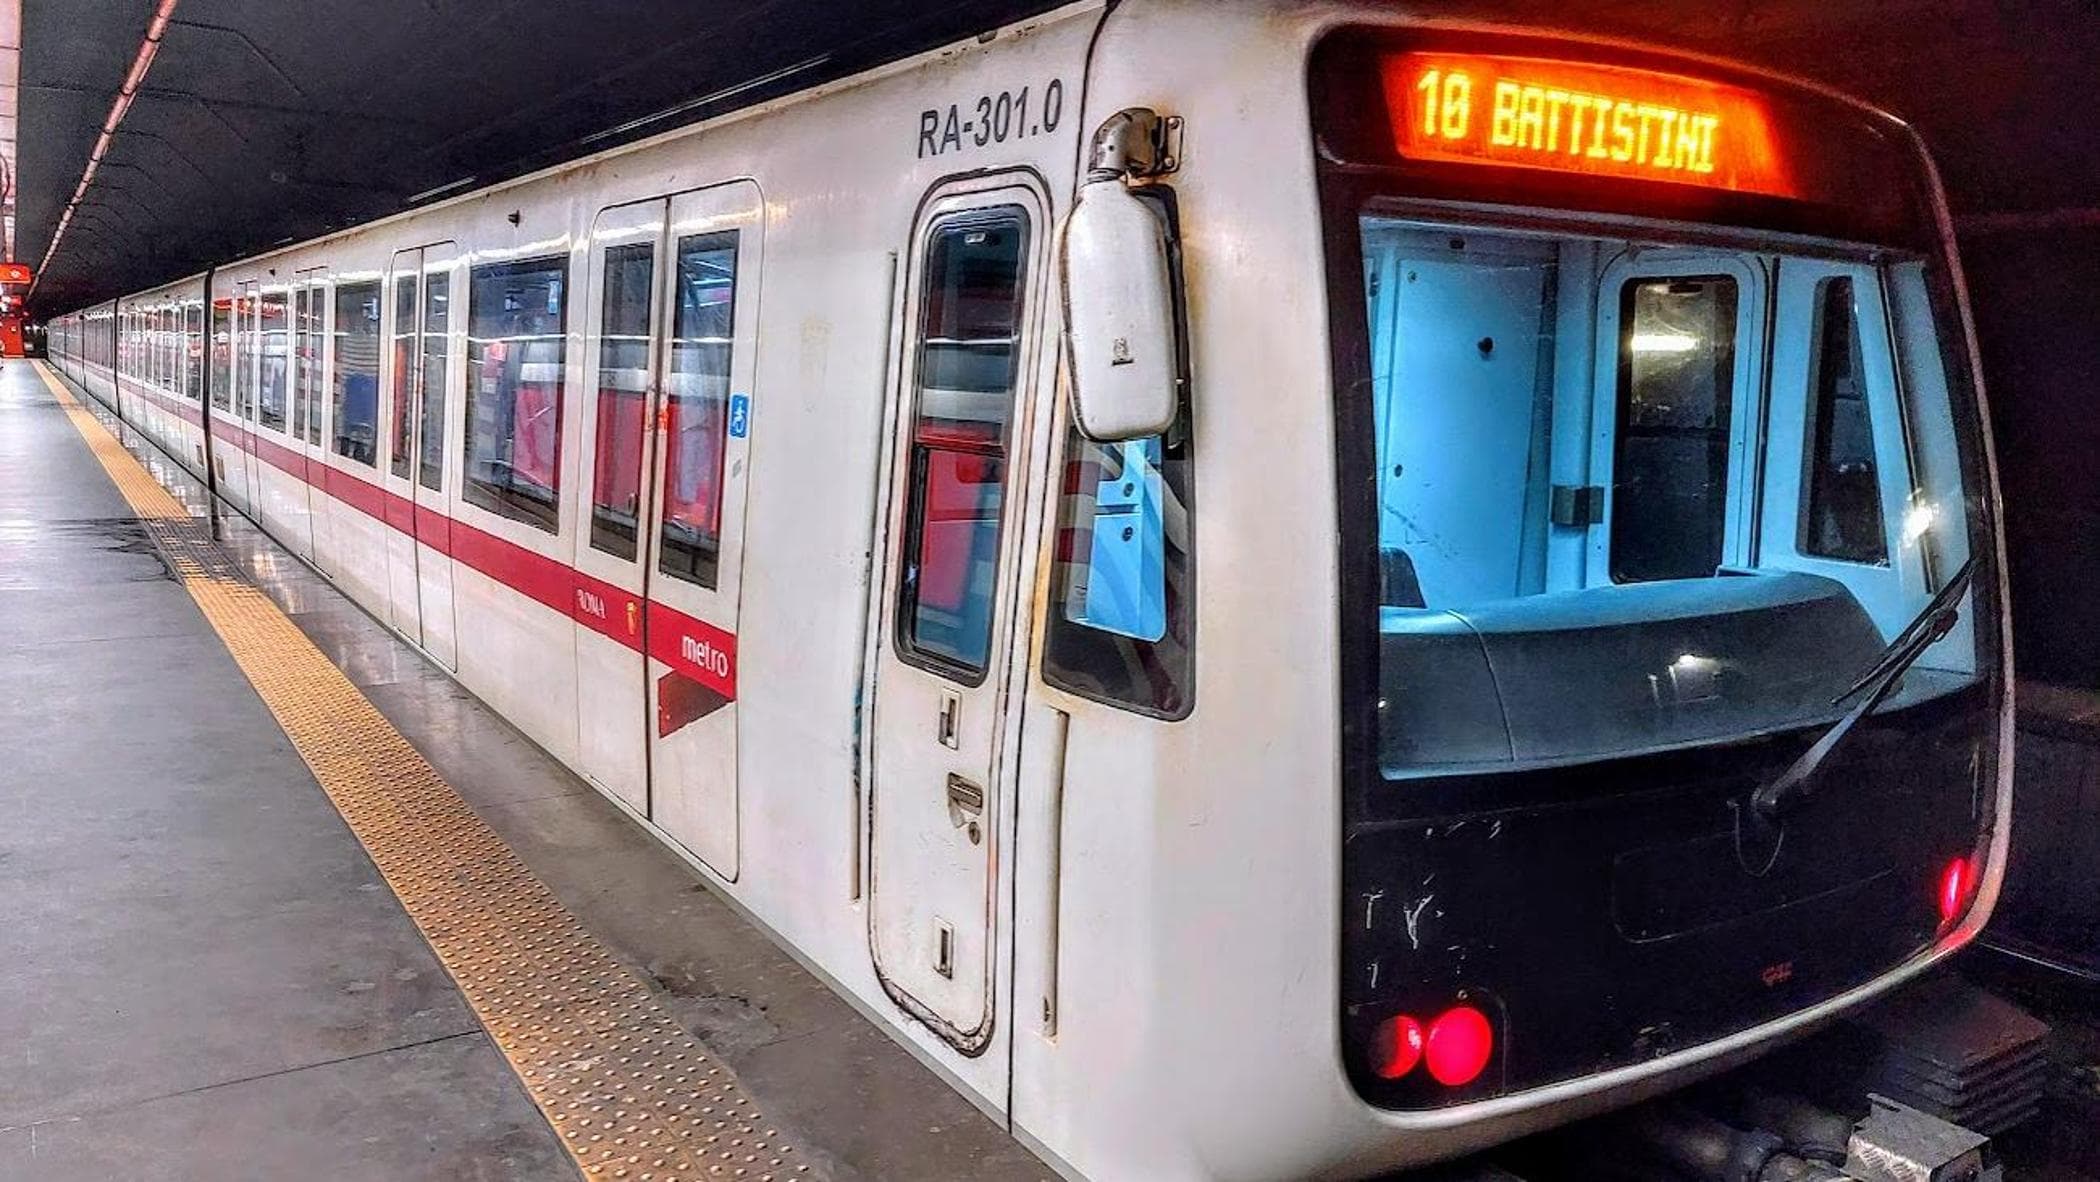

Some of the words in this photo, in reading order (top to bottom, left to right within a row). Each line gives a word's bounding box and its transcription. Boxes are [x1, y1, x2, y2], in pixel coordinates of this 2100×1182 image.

[917, 78, 1063, 160] RA-301.0
[1417, 68, 1473, 140] 10
[1490, 77, 1719, 174] BATTISTINI
[681, 633, 730, 678] metro
